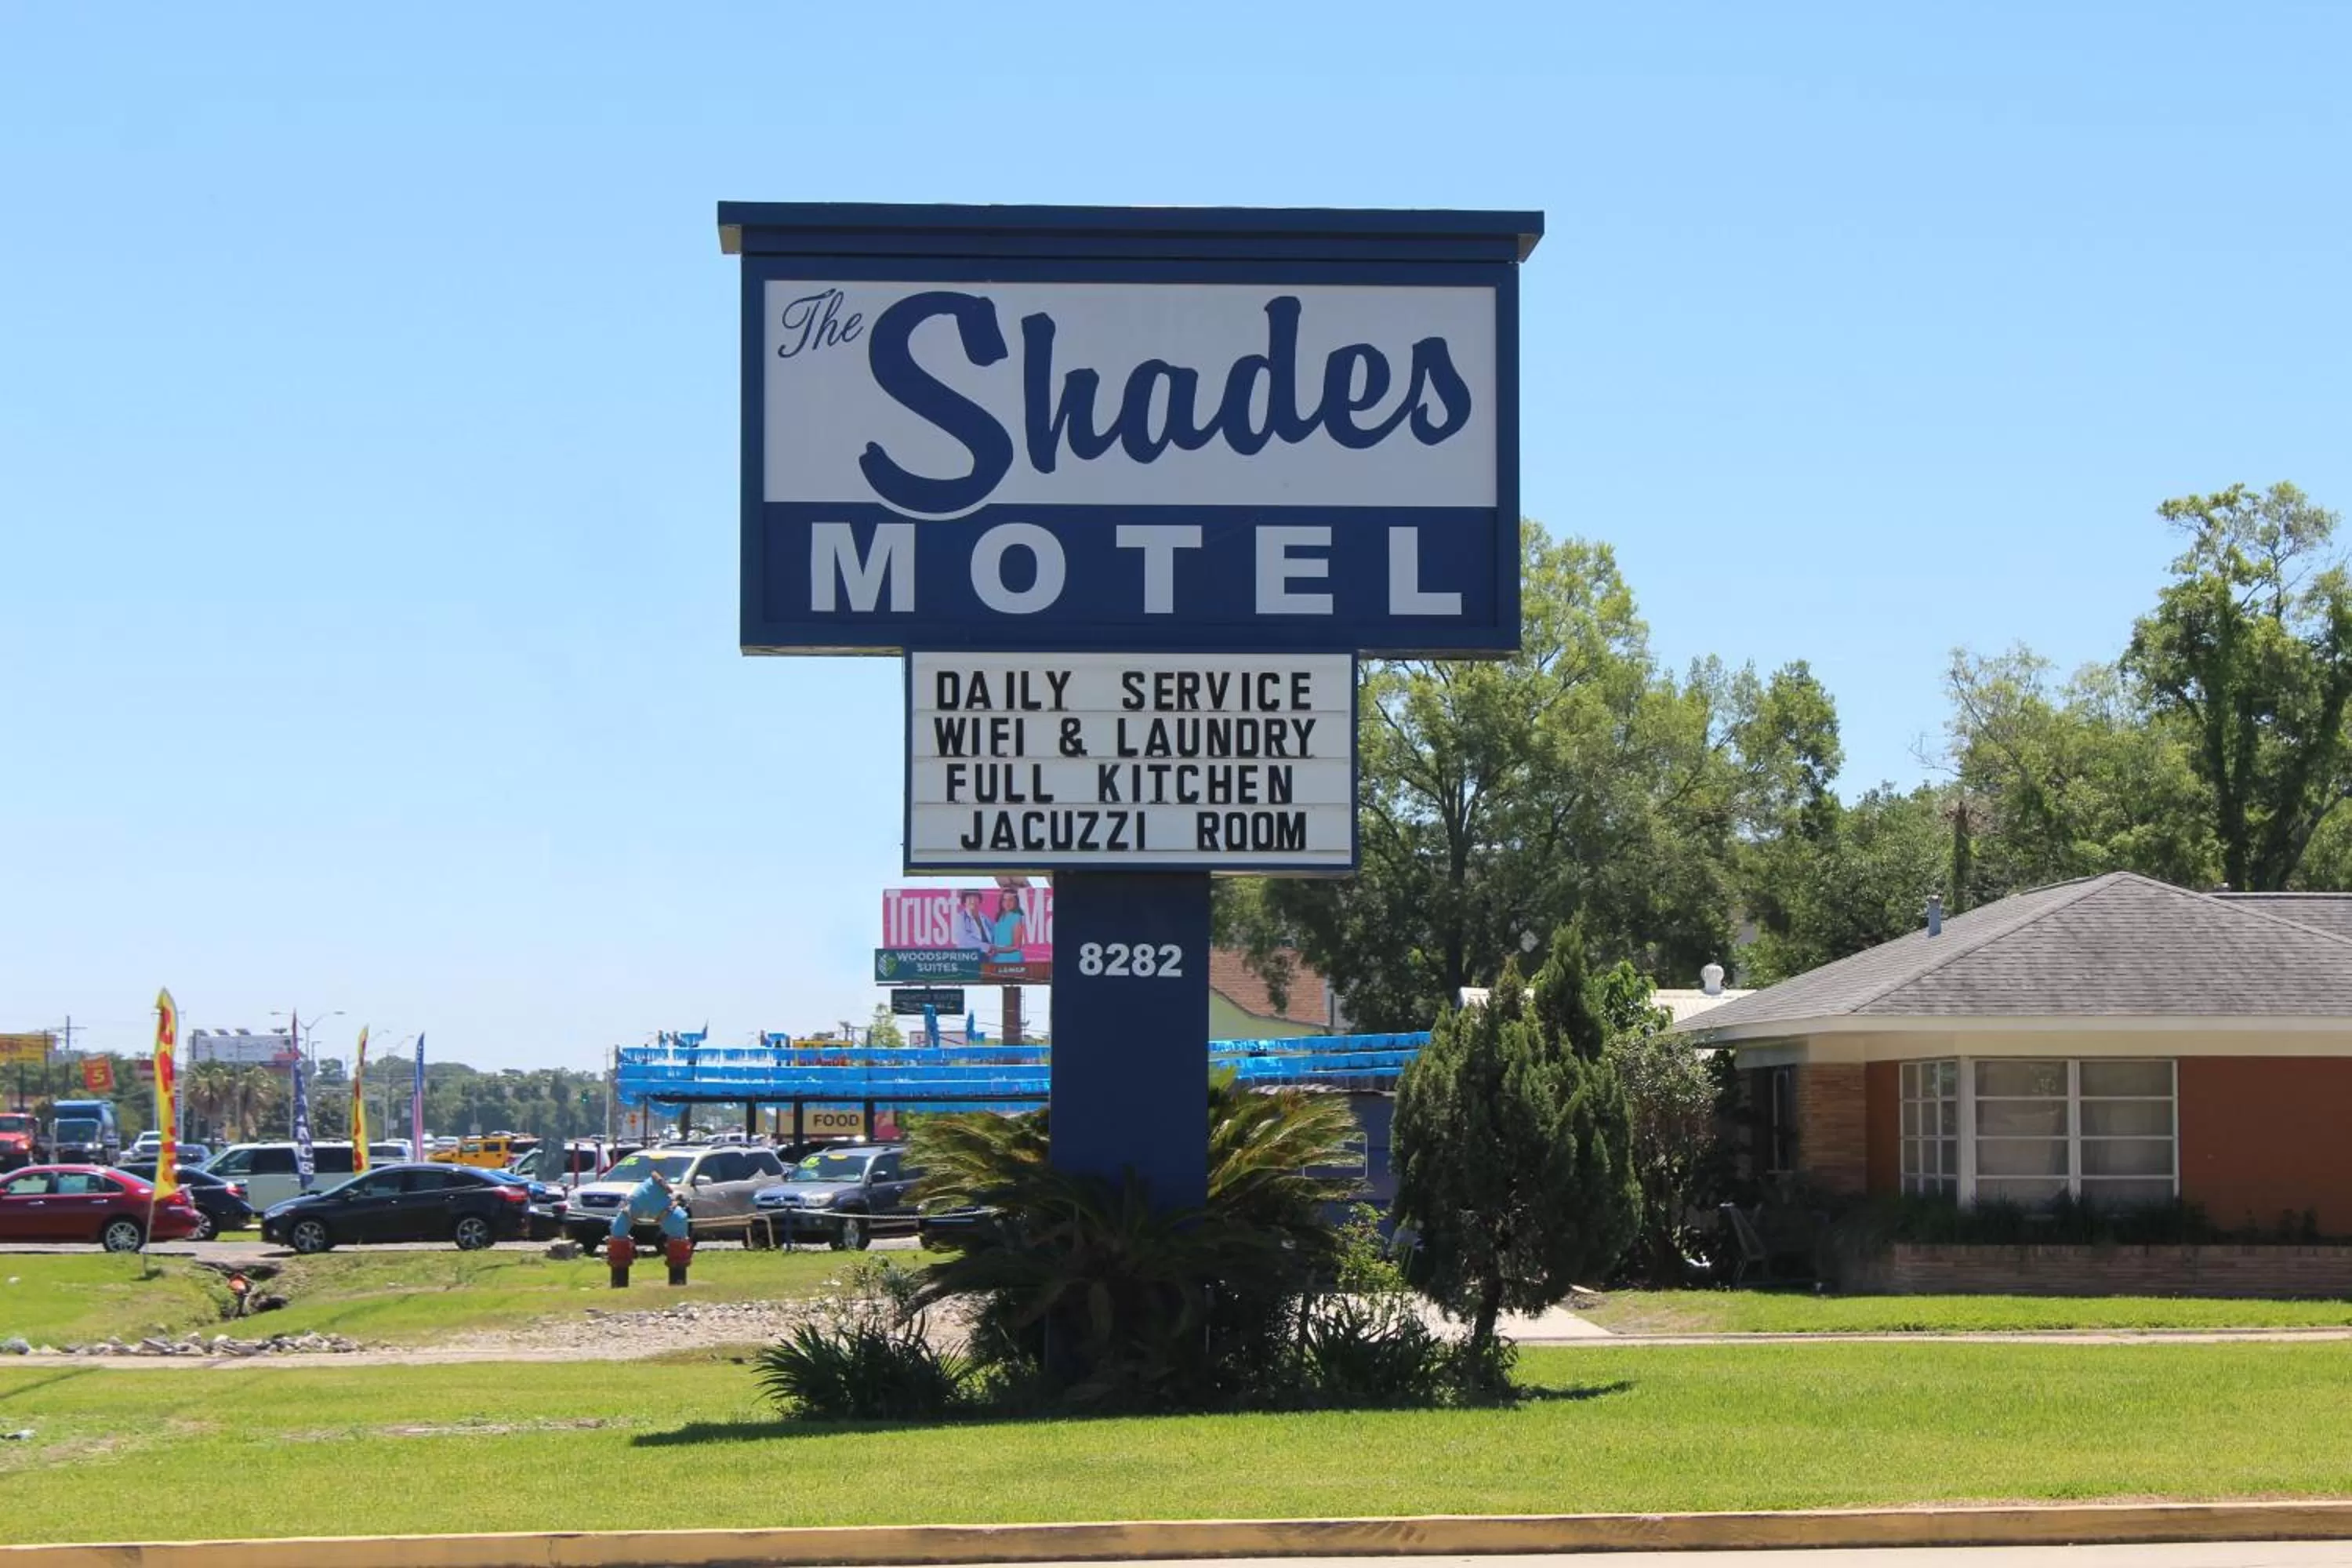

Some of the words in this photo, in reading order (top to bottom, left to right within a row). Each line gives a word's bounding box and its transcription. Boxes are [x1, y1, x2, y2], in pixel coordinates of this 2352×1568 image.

[778, 288, 864, 358] The
[859, 290, 1472, 514] Shades
[811, 521, 1462, 615] MOTEL
[936, 671, 1072, 710] DAILY
[1122, 671, 1312, 710] SERVICE
[934, 717, 1025, 757] WIFI
[1059, 718, 1087, 757] &
[1117, 717, 1316, 758] LAUNDRY
[946, 763, 1054, 803] FULL
[1098, 764, 1293, 804] KITCHEN
[960, 810, 1146, 851] JACUZZI
[1196, 811, 1306, 851] ROOM
[886, 888, 962, 948] Trust
[897, 952, 978, 962] WOODSPRING
[916, 963, 958, 973] SUITES
[1079, 942, 1182, 977] 8282
[814, 1113, 860, 1127] FOOD
